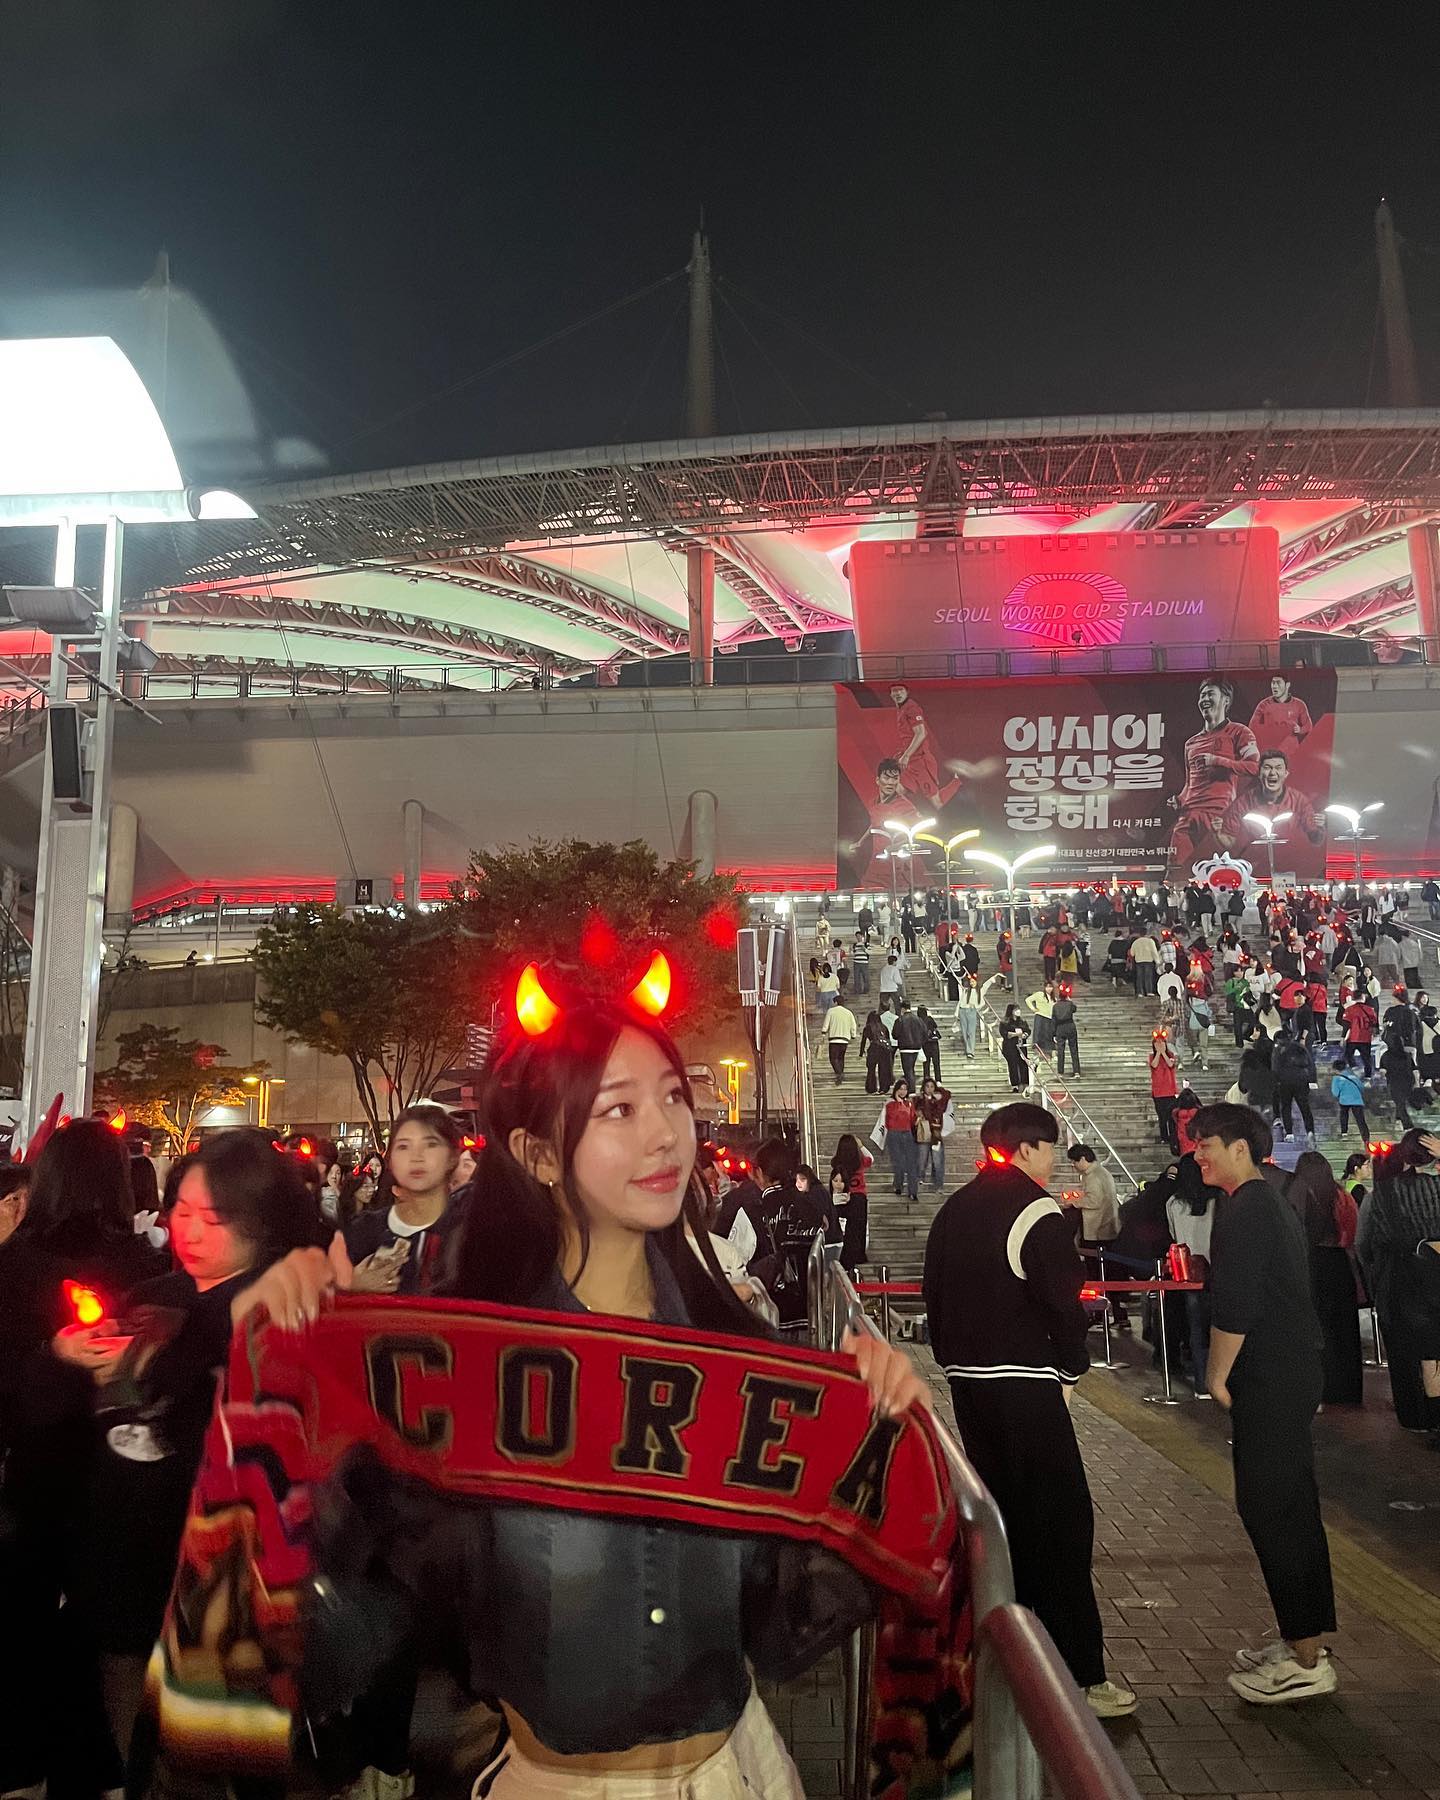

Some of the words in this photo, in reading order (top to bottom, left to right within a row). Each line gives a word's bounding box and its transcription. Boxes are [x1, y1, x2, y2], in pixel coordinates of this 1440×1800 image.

[934, 606, 992, 624] SEOUL
[1000, 604, 1066, 621] WORLD
[1072, 603, 1110, 619] CUP
[1116, 600, 1204, 617] STADIUM
[1003, 713, 1165, 752] 아시아
[1004, 754, 1165, 791] 정상을
[1003, 794, 1109, 831] 향해
[1113, 818, 1131, 828] 다시
[1134, 817, 1162, 828] 카타르
[1116, 848, 1145, 857] 대한민국
[1156, 847, 1177, 856] 튀니지
[366, 1335, 906, 1528] COREA
